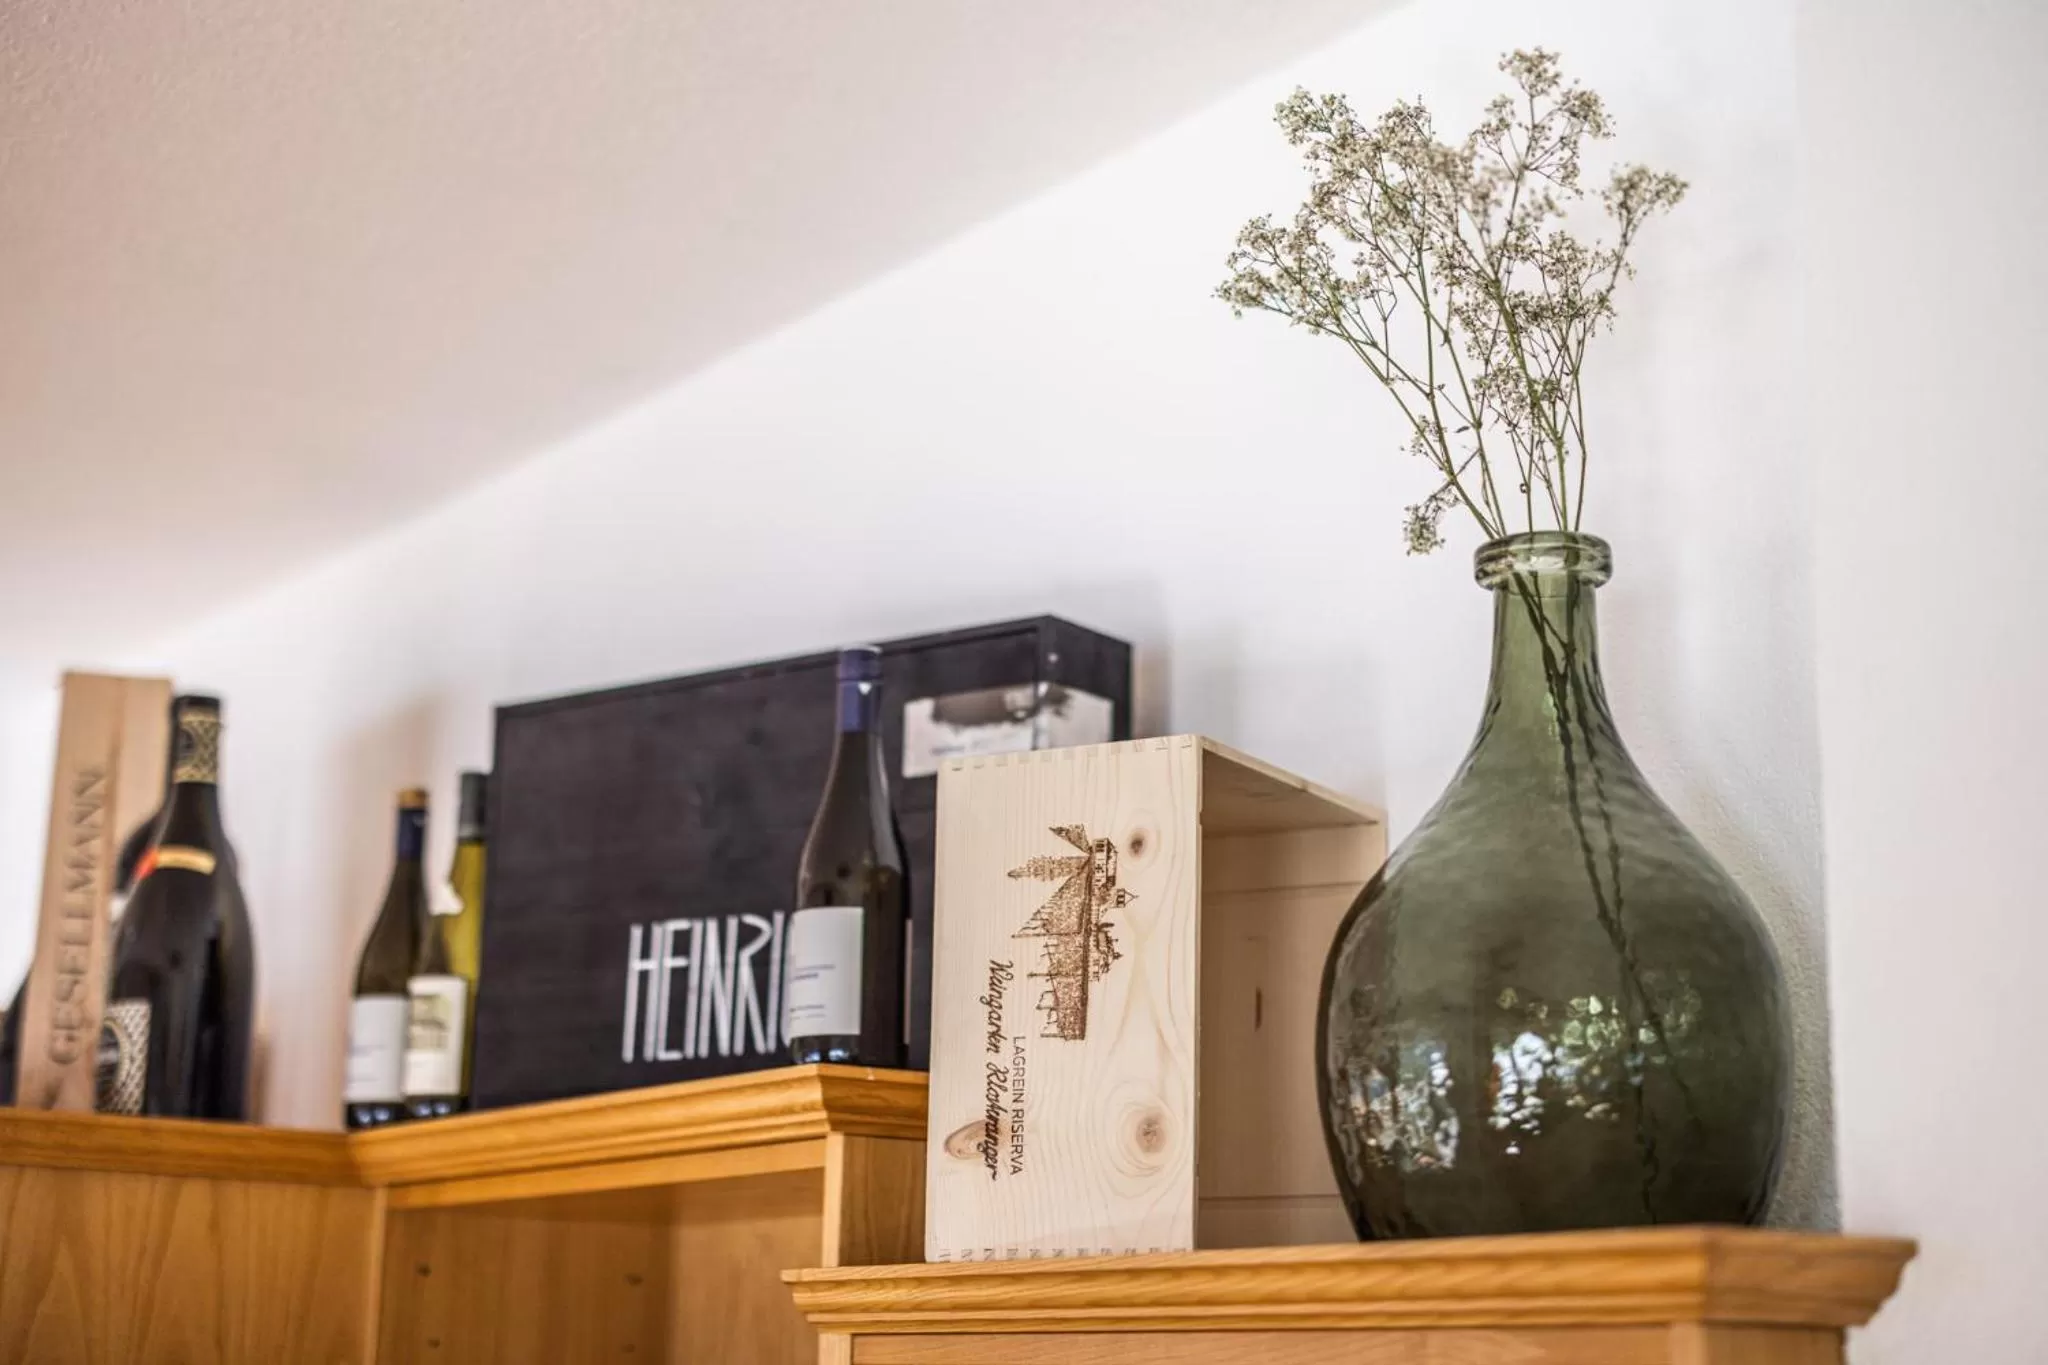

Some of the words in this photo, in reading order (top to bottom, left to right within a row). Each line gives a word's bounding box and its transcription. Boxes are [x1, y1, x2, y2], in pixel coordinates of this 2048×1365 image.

[622, 910, 913, 1063] HEINRI
[979, 958, 1015, 1055] Weingarten
[1011, 1035, 1026, 1104] LAGREIN
[976, 1062, 1010, 1181] Klosteranger
[1009, 1108, 1025, 1176] RISERVA
